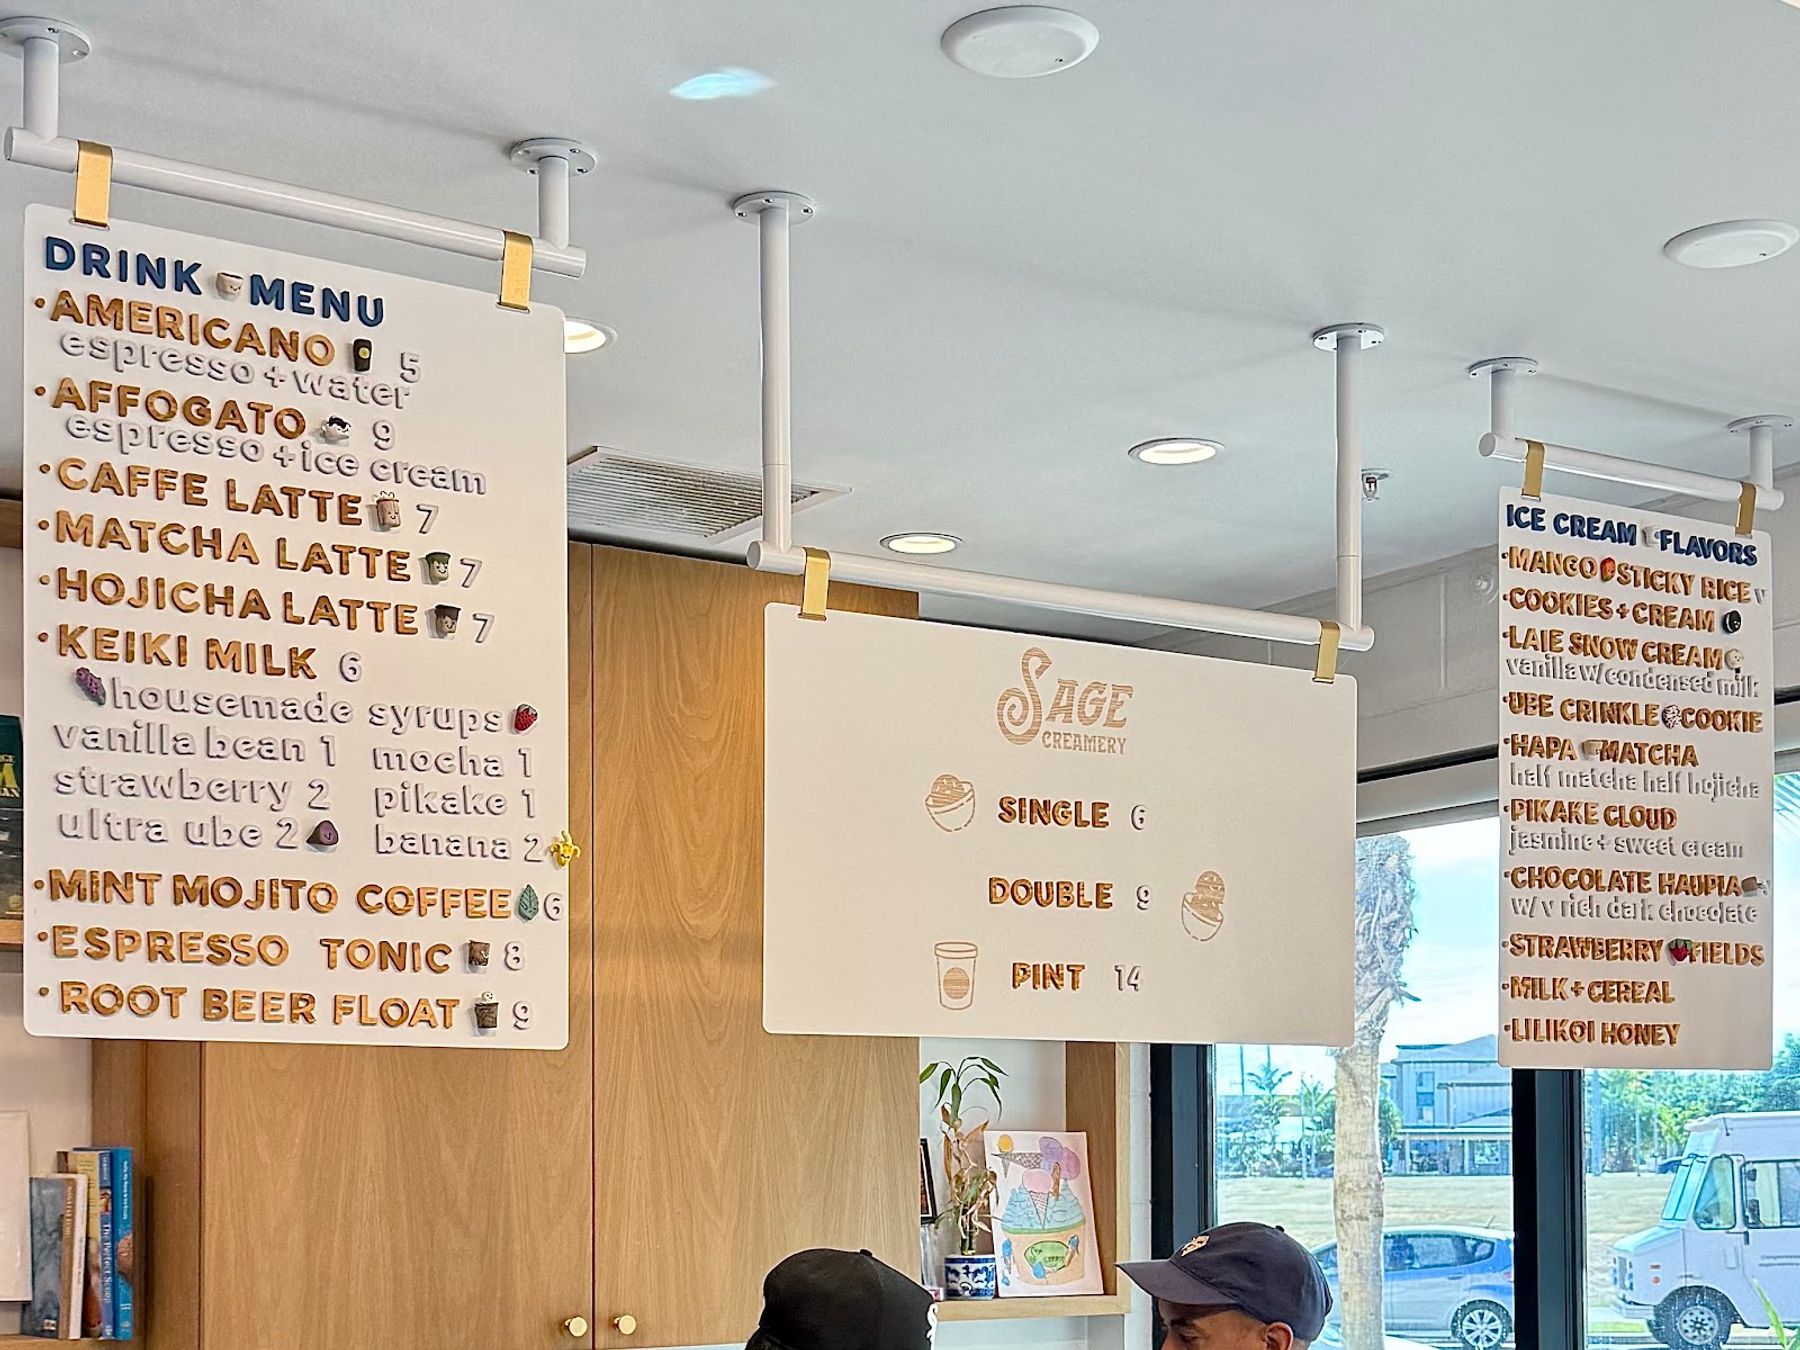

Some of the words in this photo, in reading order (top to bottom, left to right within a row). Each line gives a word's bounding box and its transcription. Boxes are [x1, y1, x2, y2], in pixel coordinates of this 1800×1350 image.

[45, 236, 203, 296] DRINK
[249, 274, 384, 328] MENU
[50, 290, 336, 367] AMERICANO
[399, 352, 422, 383] 5
[60, 328, 255, 385] espresso
[294, 368, 413, 409] water
[51, 376, 307, 440] AFFOGATO
[373, 418, 396, 450] 9
[66, 413, 263, 463] espresso
[300, 444, 359, 478] ice
[370, 458, 487, 495] cream
[57, 458, 208, 507] CAFFE
[227, 478, 363, 526] LATTE
[416, 503, 440, 534] 7
[54, 509, 261, 564] MATCHA
[275, 537, 412, 583] LATTE
[459, 558, 483, 588] 7
[1506, 504, 1546, 531] ICE
[1553, 513, 1637, 546] CREAM
[1659, 529, 1758, 566] FLAVORS
[1508, 547, 1597, 579] MANGO
[1617, 563, 1695, 596] STICKY
[1701, 577, 1751, 603] RICE
[56, 568, 272, 620] HOJICHA
[283, 593, 418, 636] LATTE
[472, 613, 495, 644] 7
[1508, 587, 1613, 620] COOKIES
[1632, 602, 1715, 632] CREAM
[57, 624, 188, 666] KEIKI
[206, 638, 318, 680] MILK
[338, 651, 363, 683] 6
[1508, 626, 1564, 652] LAIE
[1569, 632, 1638, 660] SNOW
[1641, 642, 1723, 670] CREAM
[996, 647, 1134, 746] SAGE
[1506, 654, 1576, 680] vanilla
[1718, 674, 1759, 698] milk
[111, 677, 353, 724] housemade
[368, 703, 504, 739] syrups
[1508, 692, 1554, 717] UBE
[1560, 698, 1660, 727] CRINKLE
[1681, 708, 1763, 733] COOKIE
[53, 722, 196, 756] vanilla
[206, 727, 306, 763] bean
[319, 735, 337, 765] 1
[372, 745, 503, 778] mocha
[517, 748, 533, 777] 1
[1042, 731, 1127, 754] CREAMERY
[1511, 734, 1577, 761] HAPA
[1599, 740, 1699, 767] MATCHA
[53, 769, 293, 811] strawberry
[307, 778, 330, 810] 2
[374, 782, 507, 819] pikake
[521, 789, 536, 818] 1
[1510, 763, 1552, 787] half
[1558, 768, 1637, 790] matcha
[1643, 771, 1681, 793] half
[1688, 772, 1760, 802] hojicha
[56, 809, 169, 843] ultra
[185, 817, 262, 848] ube
[276, 818, 300, 849] 2
[998, 796, 1109, 828] SINGLE
[1131, 804, 1148, 831] 6
[1511, 799, 1599, 825] PIKAKE
[1603, 805, 1677, 830] CLOUD
[375, 824, 511, 860] banana
[523, 832, 545, 863] 2
[1509, 825, 1594, 855] jasmine
[1614, 836, 1677, 856] sweet
[1682, 840, 1744, 858] cream
[48, 869, 162, 905] MINT
[173, 875, 338, 913] MOJITO
[356, 883, 512, 919] COFFEE
[543, 893, 563, 921] 6
[988, 877, 1113, 909] DOUBLE
[1136, 885, 1151, 911] 9
[1511, 866, 1652, 893] CHOCOLATE
[1658, 872, 1743, 897] HAUPIA
[1561, 893, 1601, 918] rich
[1607, 896, 1654, 921] dark
[1659, 899, 1758, 924] chocolate
[51, 926, 290, 967] ESPRESSO
[320, 939, 453, 973] TONIC
[503, 942, 525, 971] 8
[1509, 933, 1663, 962] STRAWBERRY
[1688, 942, 1765, 967] FIELDS
[1012, 962, 1085, 991] PINT
[1114, 964, 1142, 992] 14
[1510, 976, 1568, 1001] MILK
[1587, 980, 1675, 1003] CEREAL
[59, 981, 188, 1019] ROOT
[203, 988, 318, 1024] BEER
[332, 995, 460, 1029] FLOAT
[512, 1001, 533, 1030] 9
[1511, 1018, 1595, 1042] LILIKOI
[1601, 1022, 1681, 1046] HONEY
